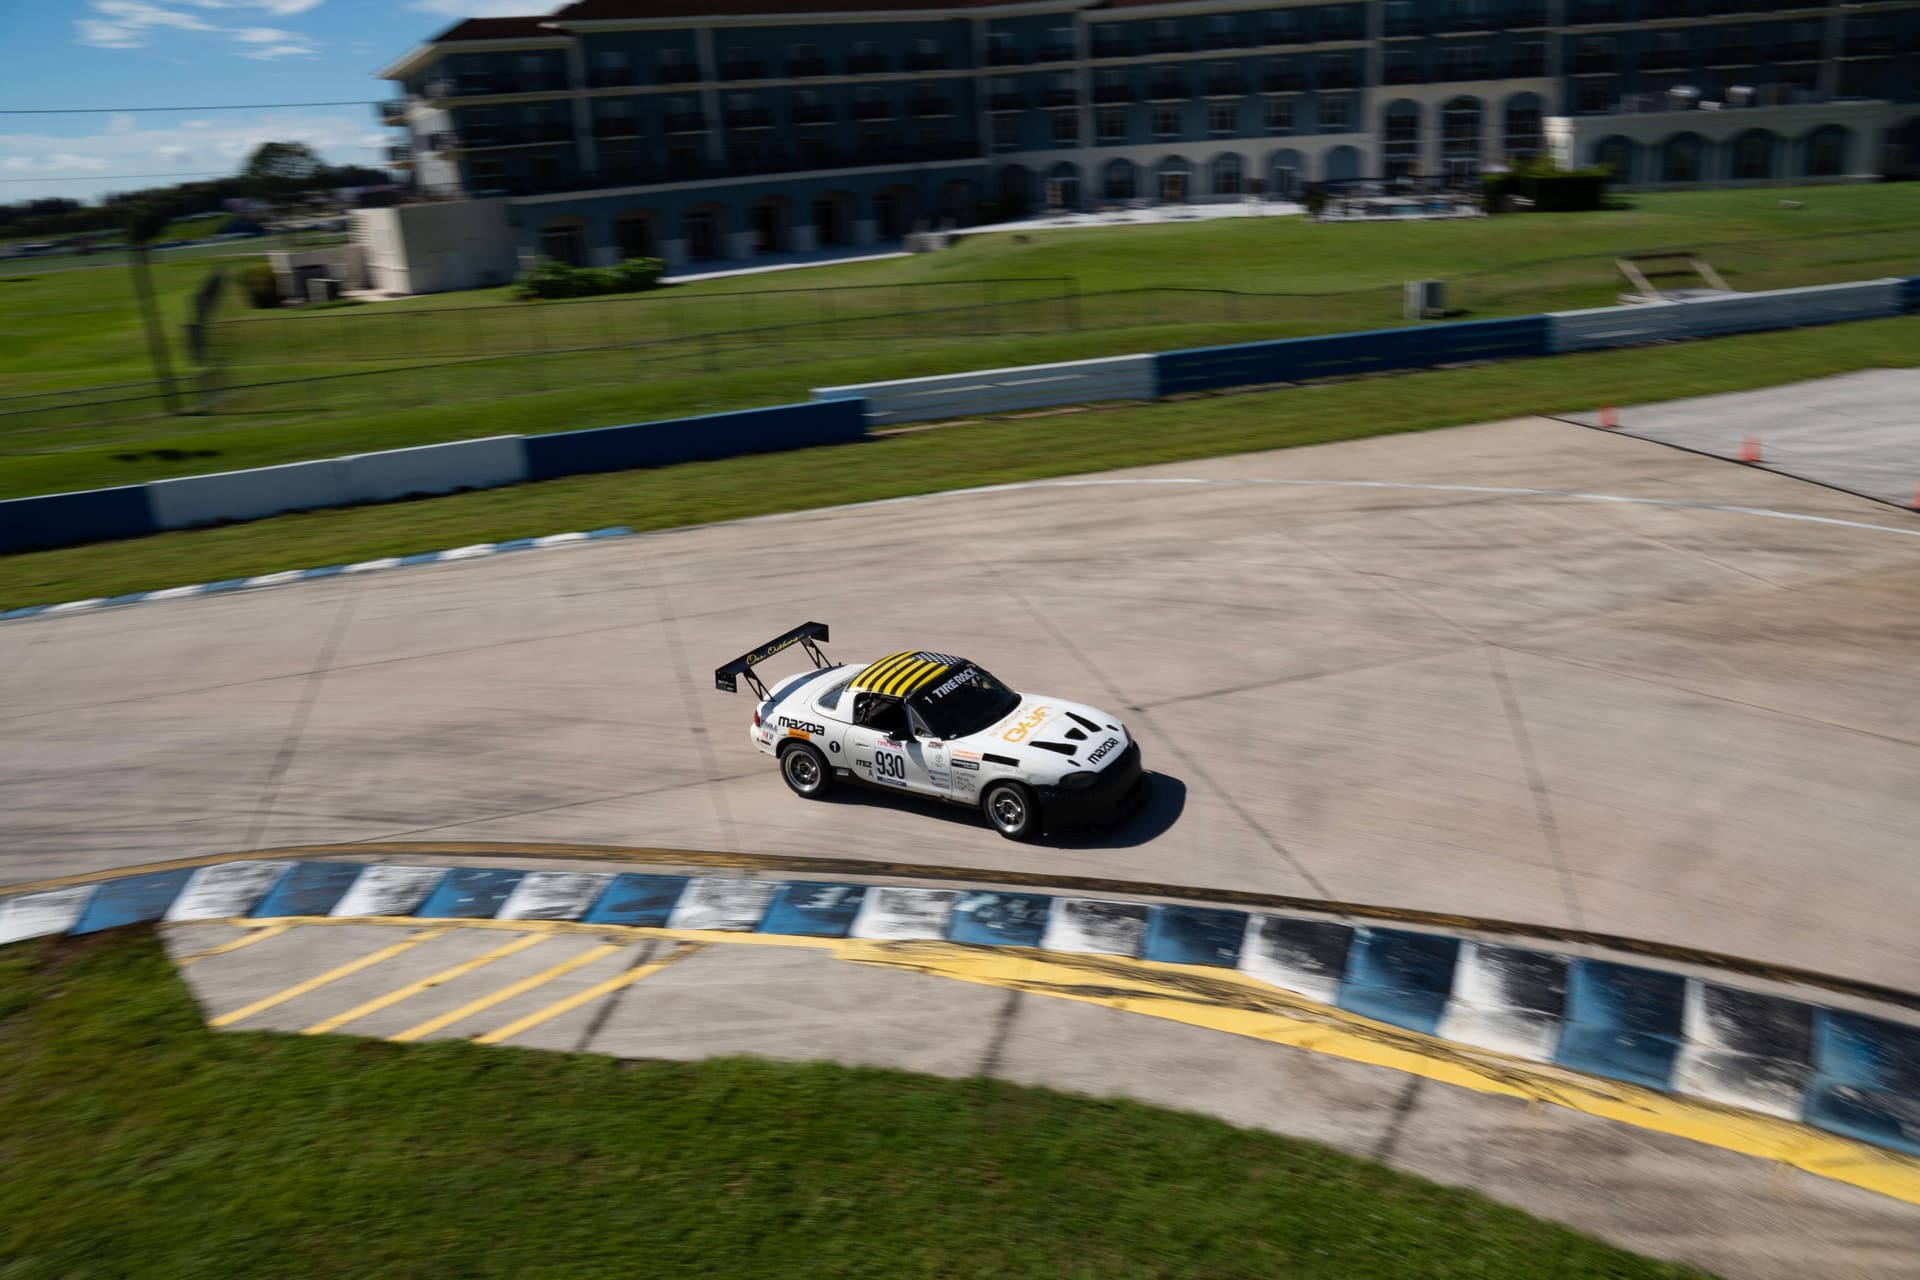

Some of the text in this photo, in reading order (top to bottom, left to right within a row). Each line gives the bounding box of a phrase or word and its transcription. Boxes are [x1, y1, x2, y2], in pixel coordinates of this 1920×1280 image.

[932, 679, 959, 698] TIRE
[953, 667, 978, 685] RACK
[778, 716, 825, 736] mazda
[876, 750, 905, 780] 930
[1087, 737, 1120, 765] mazda
